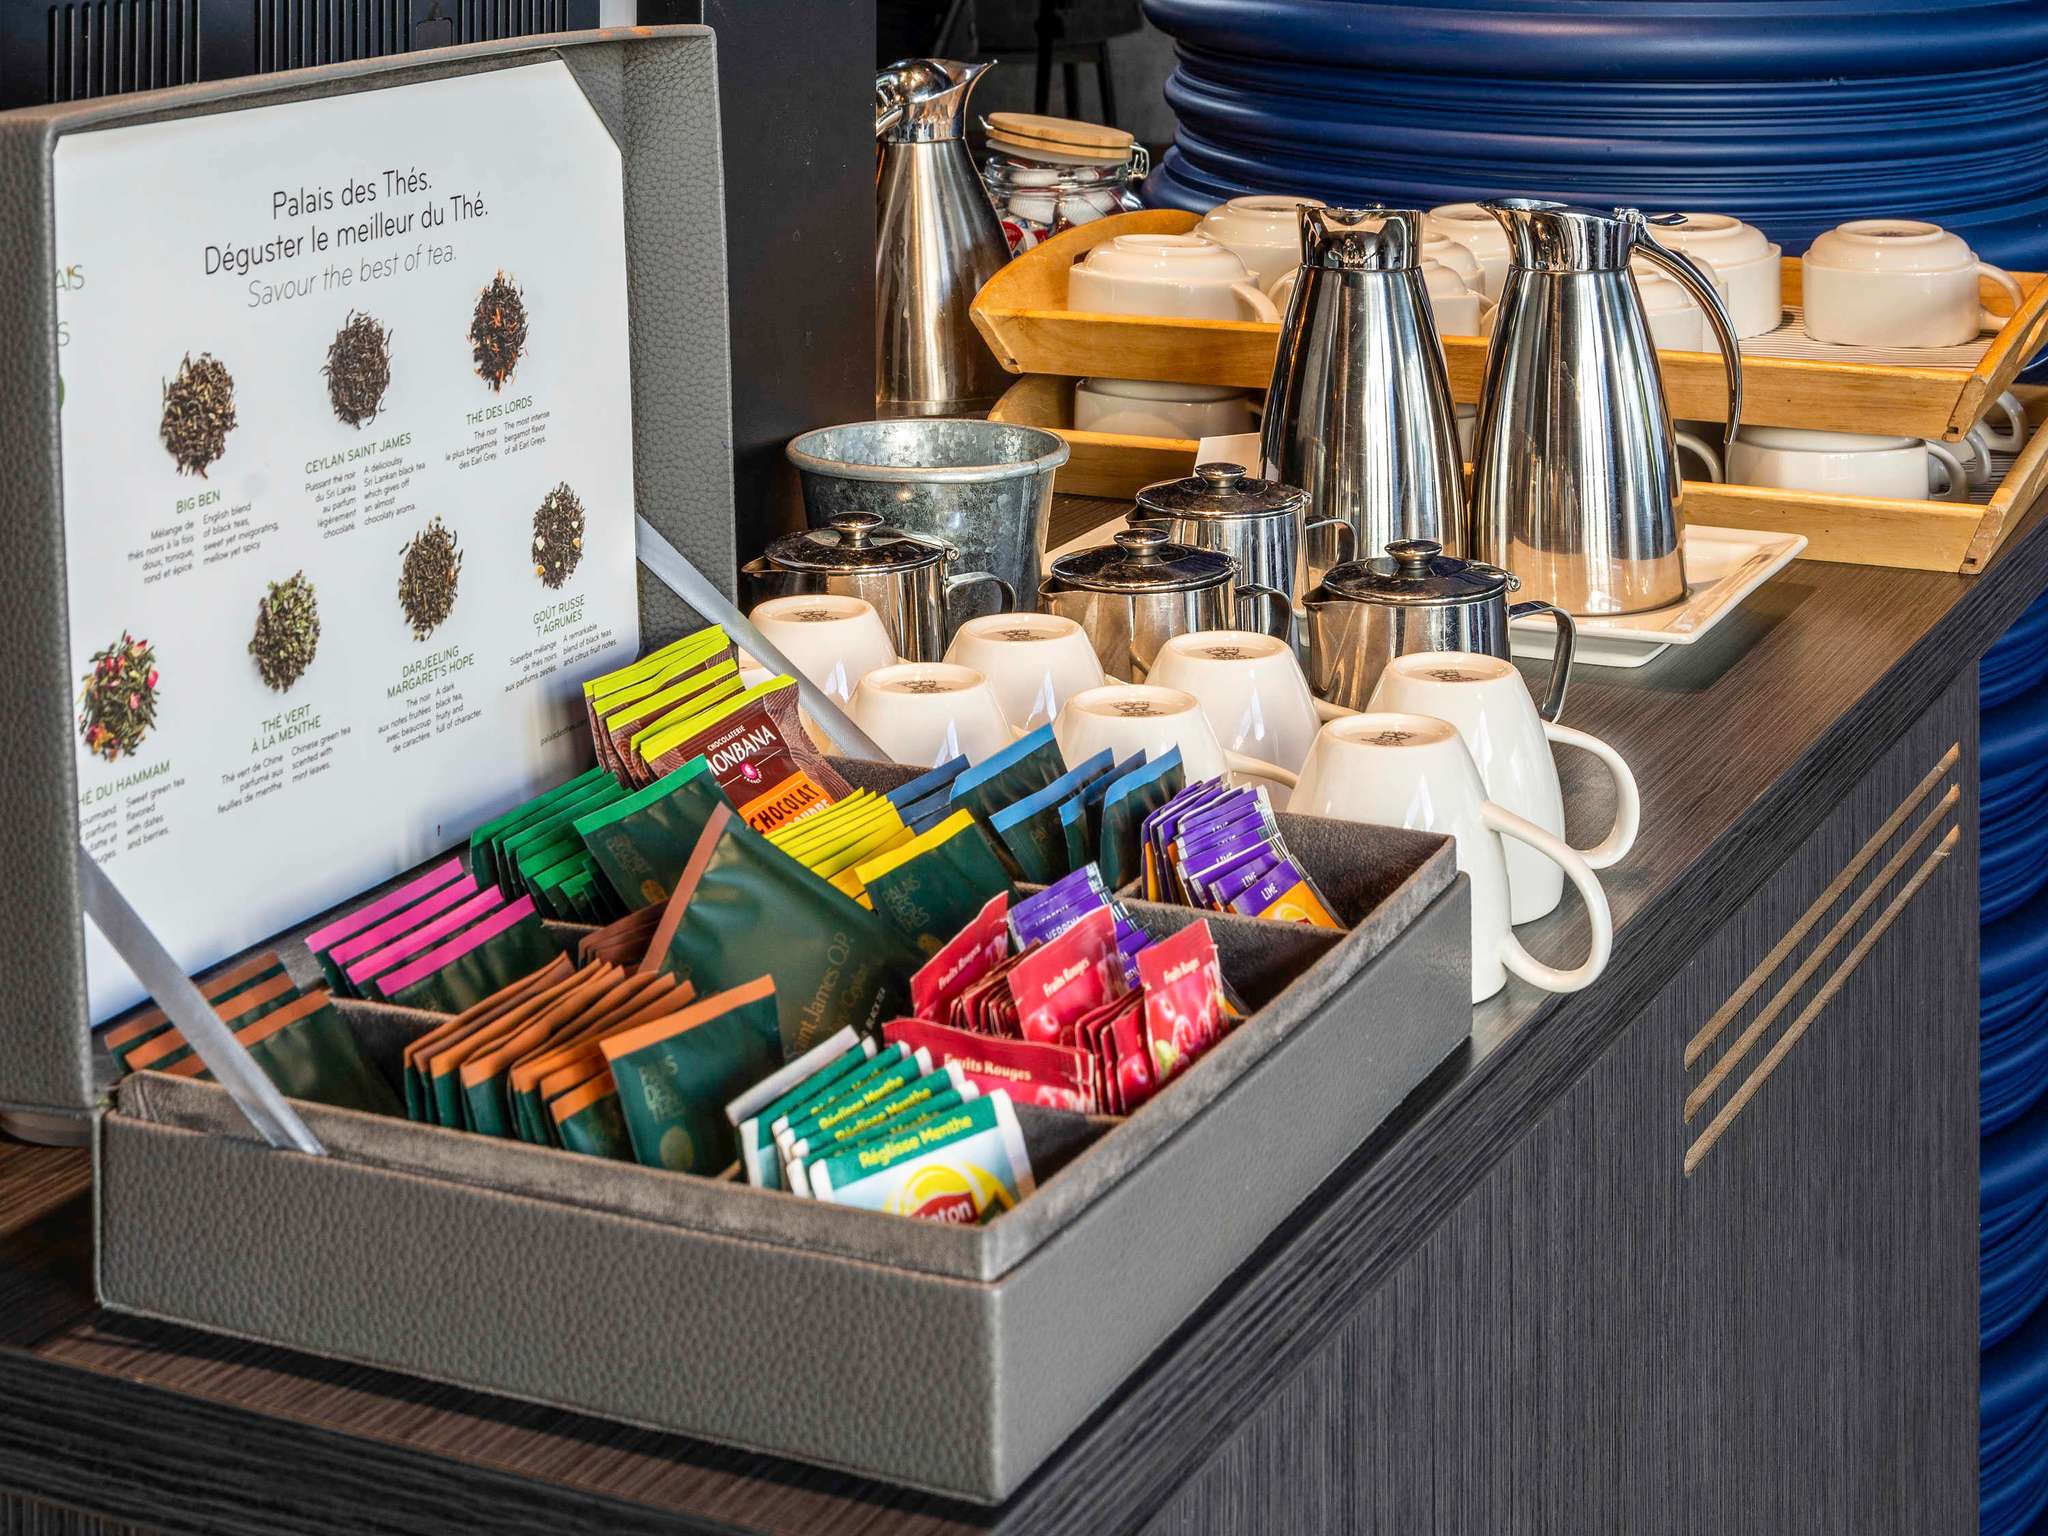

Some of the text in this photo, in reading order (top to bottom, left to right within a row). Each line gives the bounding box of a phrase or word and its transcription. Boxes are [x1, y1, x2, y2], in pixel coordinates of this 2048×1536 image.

[273, 167, 432, 219] Palais des Thés.
[205, 192, 488, 275] Déguster le meilleur du Thé.
[248, 244, 456, 308] Savour the best of tea.
[466, 396, 533, 424] THÉ DES LORDS
[504, 411, 549, 430] The most intense
[475, 428, 497, 440] Thé noir
[504, 424, 545, 443] bergamot flavor
[305, 432, 411, 474] CEYLAN SAINT JAMES
[452, 438, 497, 460] plus bergamoté
[519, 441, 529, 451] Earl
[371, 457, 403, 472] deliciously
[459, 456, 482, 470] des Earl
[305, 472, 355, 492] Puissant thé noir
[364, 462, 425, 487] Sri Lankan black tea
[315, 485, 356, 502] du Sri Lanka
[364, 478, 410, 499] which gives off
[176, 490, 220, 513] BIG BEN
[332, 497, 356, 511] parfum
[375, 497, 395, 510] almost
[203, 502, 251, 524] English blend
[317, 509, 356, 528] légèrement
[364, 510, 394, 525] chocolaty
[151, 521, 194, 540] Mélange de
[203, 524, 231, 538] of black
[146, 534, 194, 555] noirs fois
[204, 535, 236, 551] sweet yet
[203, 547, 241, 564] mellow yet
[144, 571, 161, 584] rond
[533, 594, 584, 624] GOÛT RUSSE
[536, 609, 583, 637] 7 AGRUMES
[569, 624, 597, 639] remarkable
[563, 630, 612, 654] blend black teas
[403, 645, 459, 678] DARJEELING
[510, 641, 556, 666] Superbe mélange
[522, 653, 557, 672] de thés noirs
[563, 645, 601, 666] and citrus fruit
[387, 653, 474, 698] MARGARET'S HOPE
[505, 673, 538, 692] aux parfums
[442, 684, 454, 693] dark
[406, 694, 431, 707] Thé noir
[436, 698, 451, 709] black
[262, 704, 311, 733] THÉ VERT
[379, 707, 431, 733] aux notes fruitées
[436, 704, 464, 720] fruity and
[262, 714, 320, 749] LA MENTHE
[387, 719, 432, 743] avec beaucoup
[436, 723, 445, 733] full
[707, 725, 746, 751] CHOCOLATERIE
[291, 726, 351, 756] Chinese green tea
[393, 744, 401, 752] de
[292, 747, 333, 769] scented with
[96, 760, 170, 800] DU HAMMAM
[222, 755, 283, 784] Thé vert de Chine
[292, 770, 307, 783] mint
[240, 769, 283, 793] parfumé aux
[126, 778, 184, 807] Sweet green tea
[126, 803, 155, 821] flavored
[217, 799, 242, 814] feuilles
[244, 793, 253, 803] de
[750, 784, 819, 834] CHOCOLAT
[86, 821, 117, 839] parfums
[127, 815, 163, 835] with dates
[128, 838, 141, 849] and
[1261, 883, 1278, 900] LIME
[939, 943, 981, 990] Fruits Rouges
[1043, 957, 1089, 997] Fruits Rouges
[1164, 958, 1200, 983] Fruits Rouges
[984, 1061, 1032, 1081] Rouges
[859, 1136, 919, 1168] Réglisse
[919, 1116, 972, 1144] Menthe
